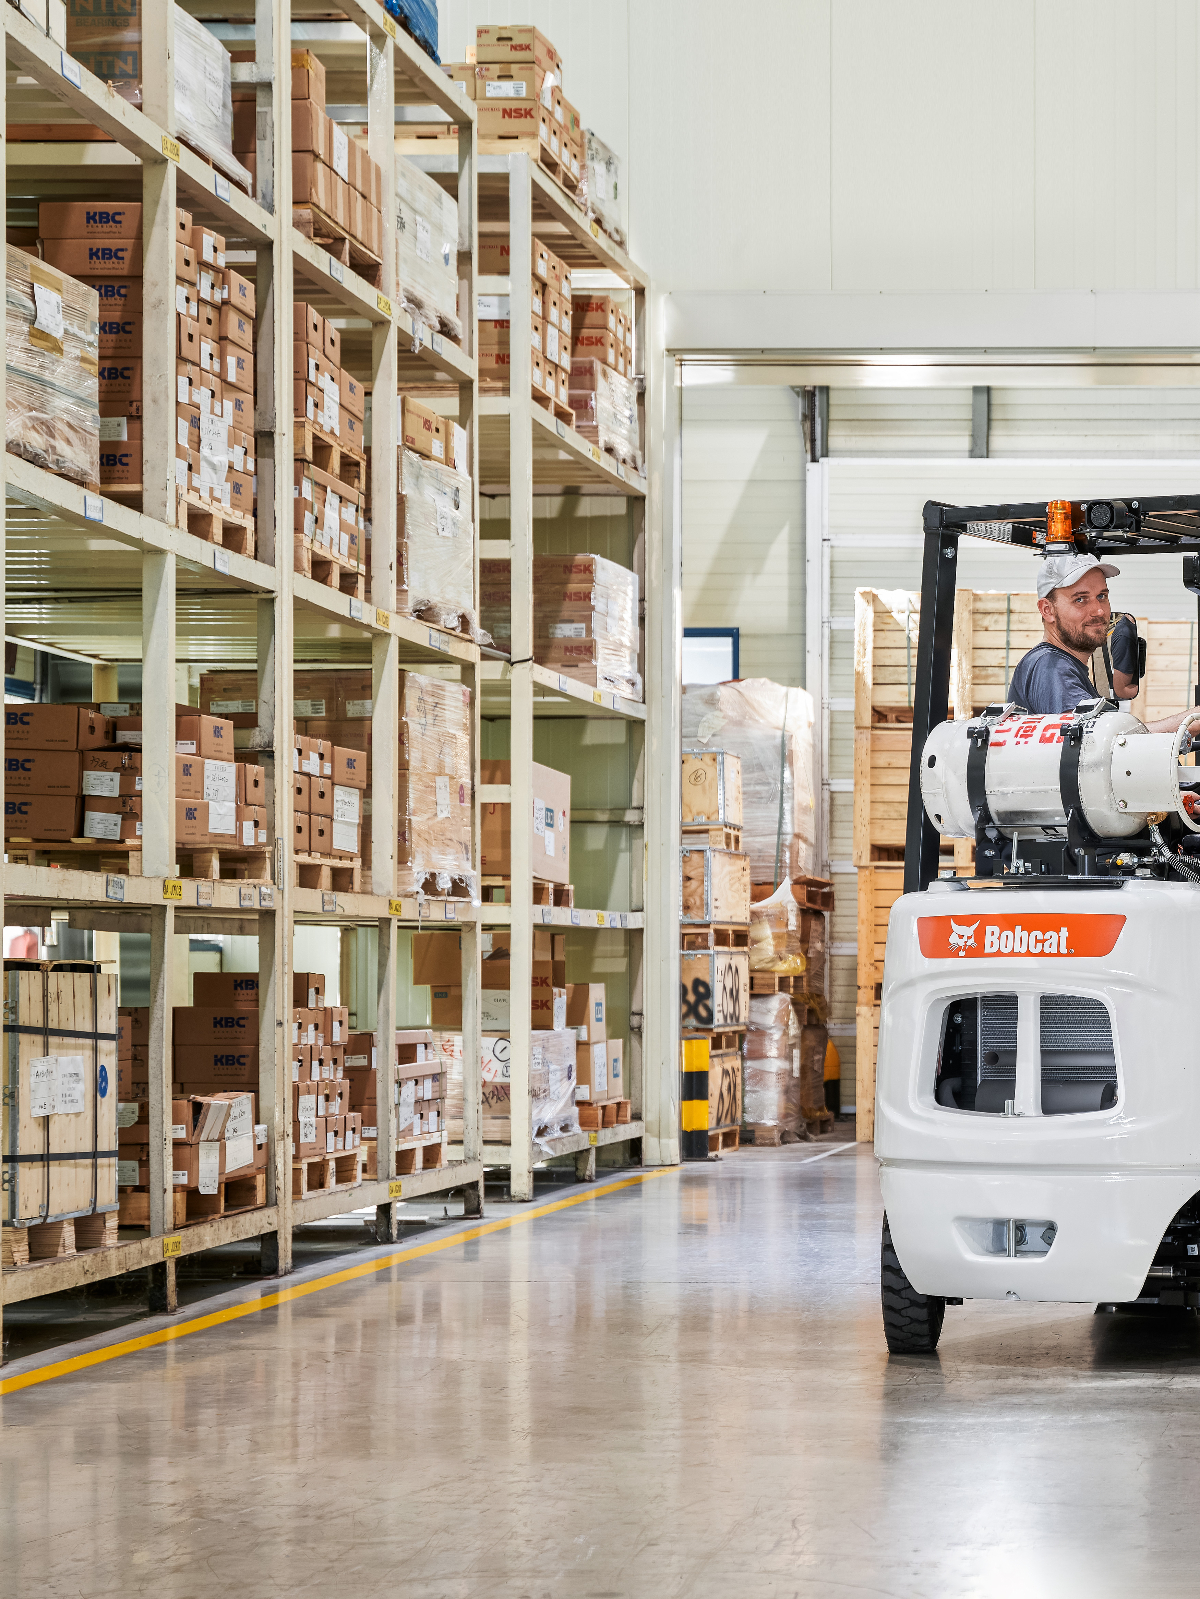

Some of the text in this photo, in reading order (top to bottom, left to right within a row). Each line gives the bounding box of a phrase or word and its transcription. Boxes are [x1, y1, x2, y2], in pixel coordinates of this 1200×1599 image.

[75, 18, 130, 27] BEARINGS
[510, 44, 532, 52] NSK
[502, 108, 534, 119] NSK
[85, 211, 122, 224] KBC
[88, 248, 124, 261] KBC
[574, 302, 604, 312] NSK
[574, 336, 604, 346] NSK
[562, 564, 594, 576] NSK
[562, 591, 593, 602] NSK
[563, 644, 594, 656] NSK
[984, 925, 1070, 954] Bobcat
[234, 980, 259, 990] KB
[212, 1016, 246, 1028] KBC
[214, 1054, 246, 1066] KBC
